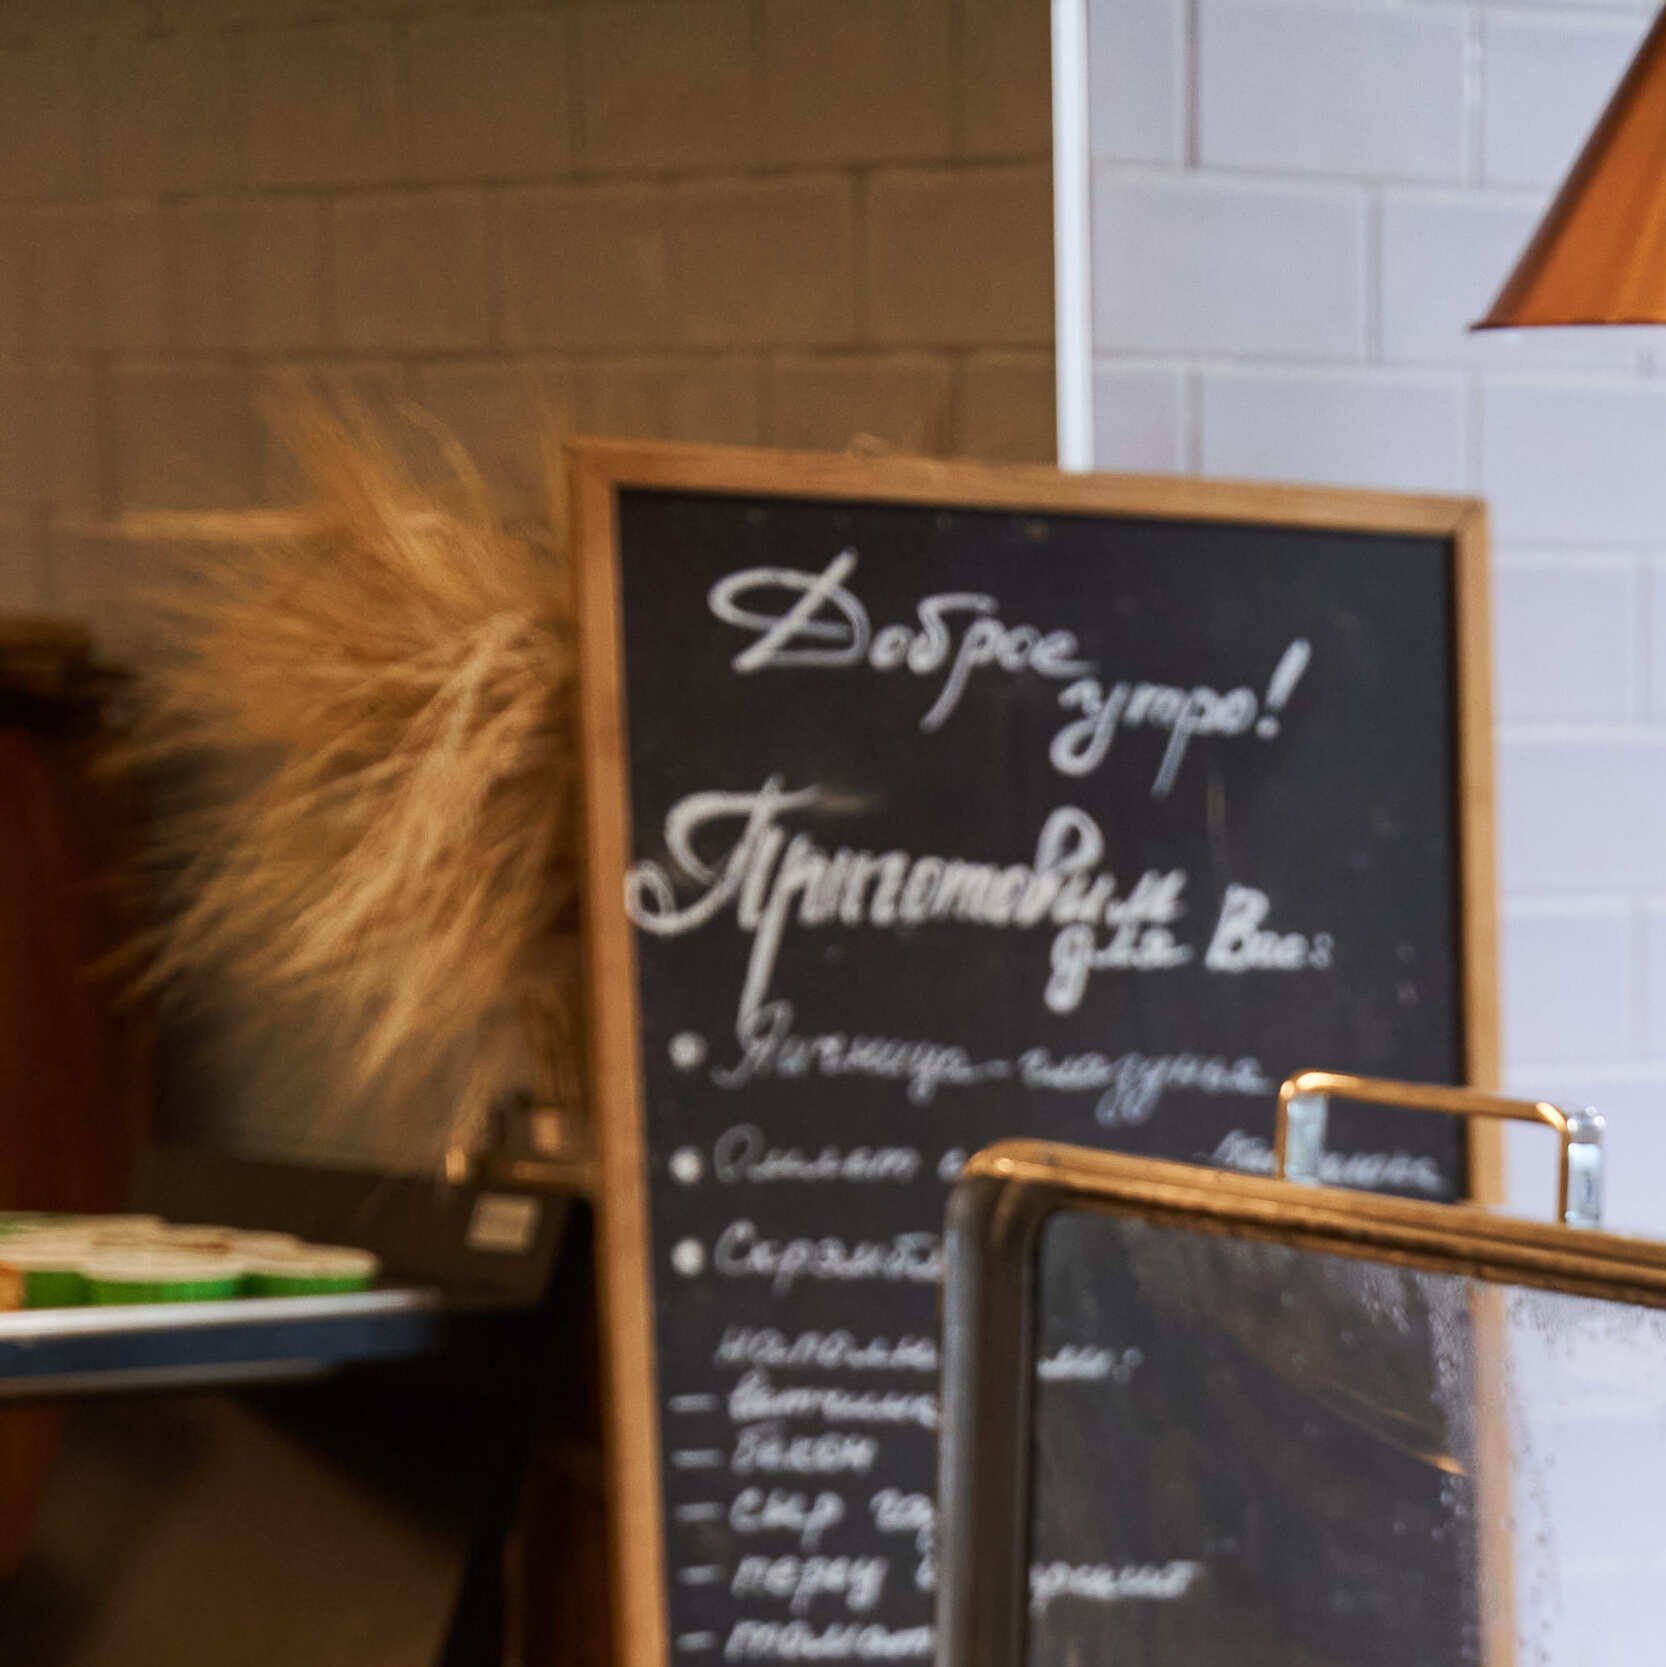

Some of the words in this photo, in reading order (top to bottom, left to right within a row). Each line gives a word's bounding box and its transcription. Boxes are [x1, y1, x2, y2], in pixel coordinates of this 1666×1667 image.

[707, 546, 1096, 732] Доброе
[1050, 637, 1312, 798] утро!
[1044, 925, 1191, 1016] для
